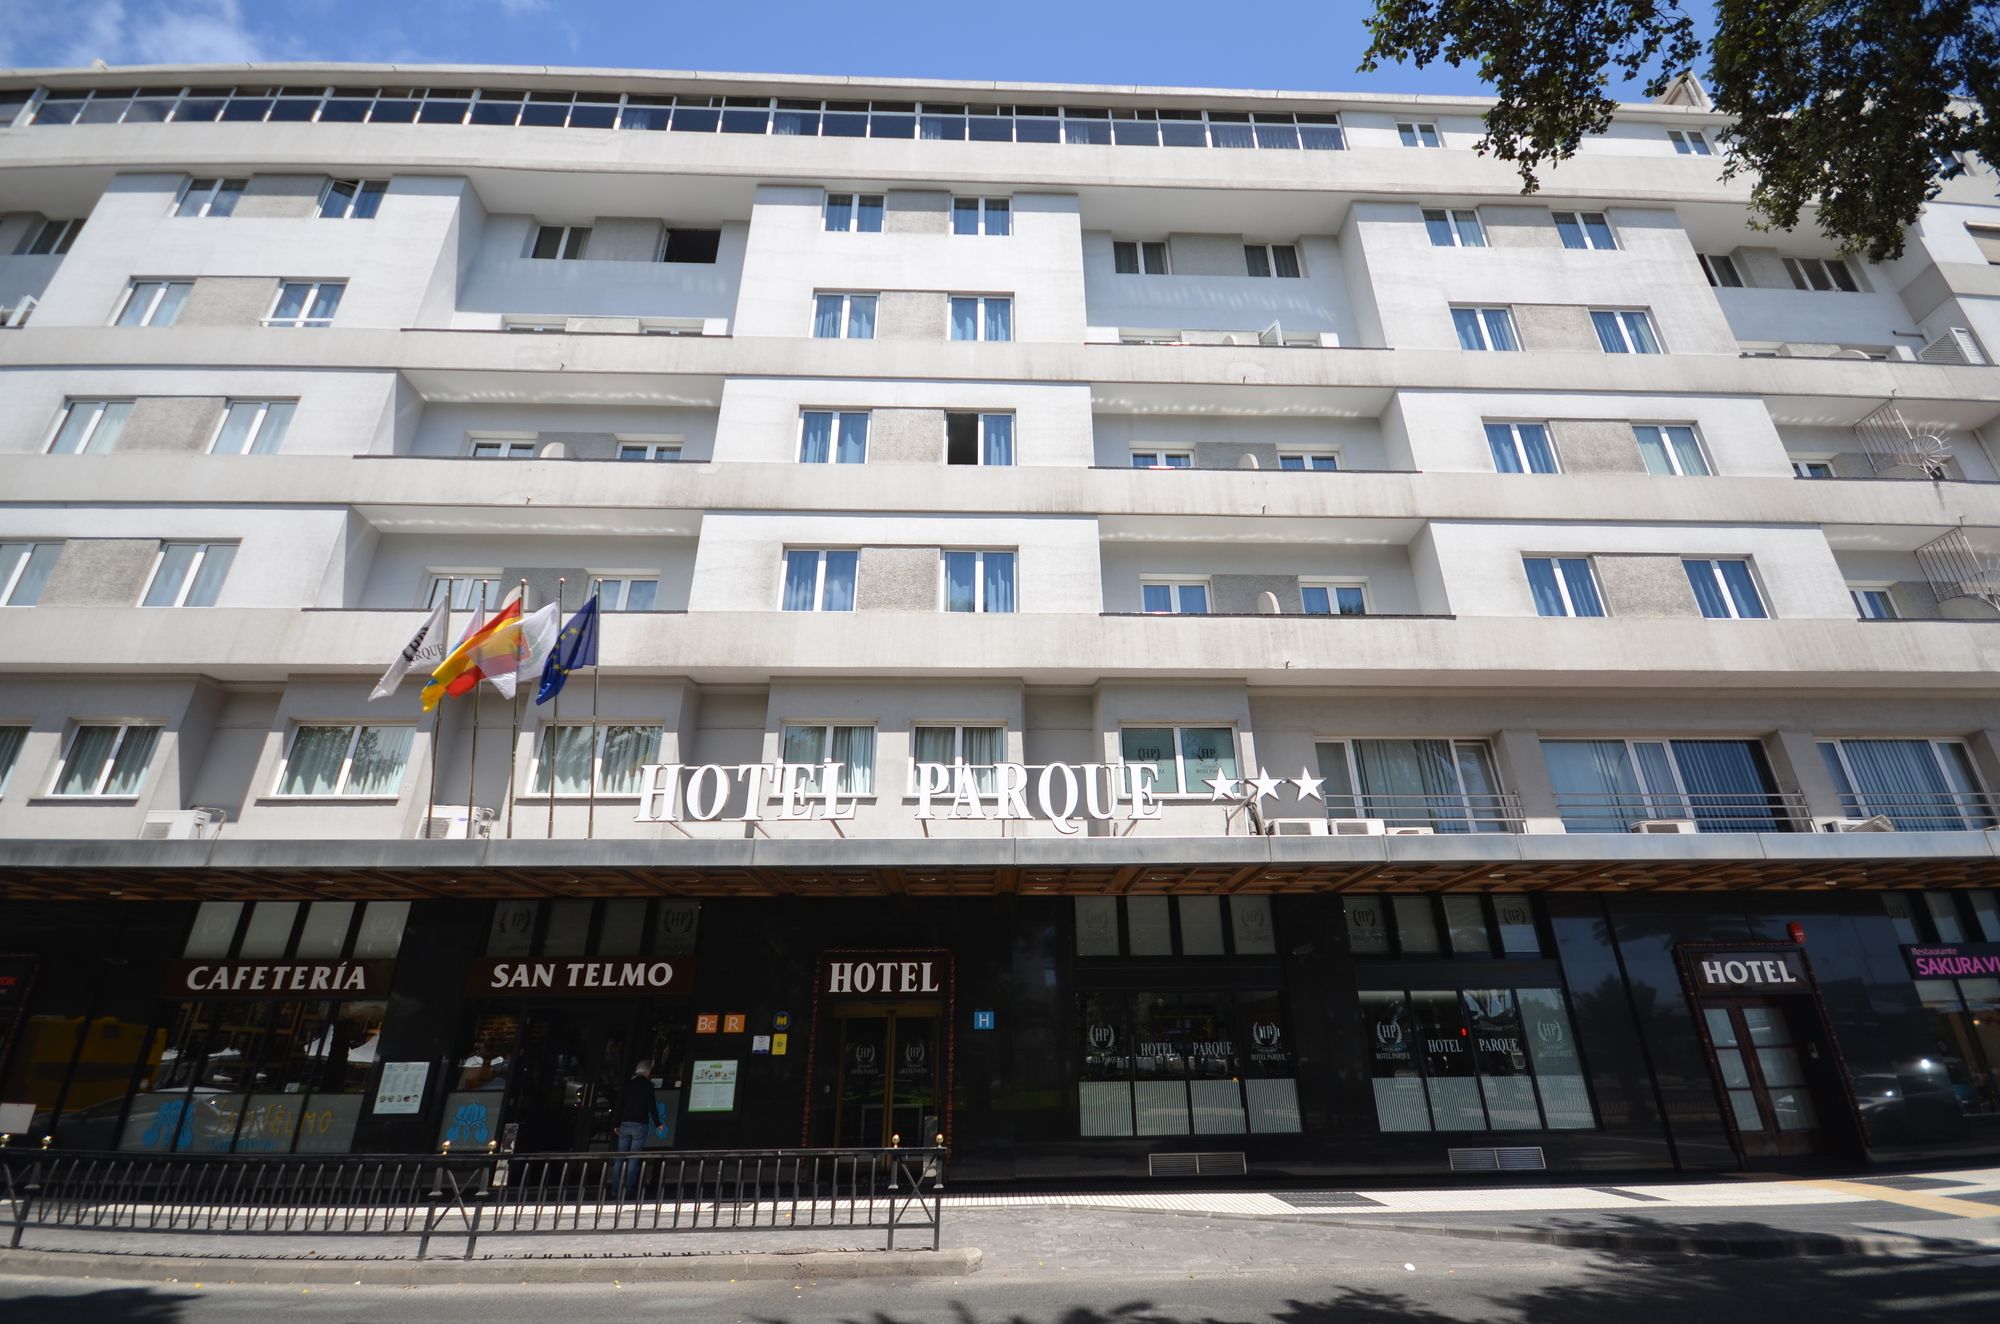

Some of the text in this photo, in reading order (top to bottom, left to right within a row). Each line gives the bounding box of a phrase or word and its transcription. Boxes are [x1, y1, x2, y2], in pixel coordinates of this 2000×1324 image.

[633, 762, 1163, 834] HOTEL PARQUE
[671, 912, 688, 927] HP
[1911, 947, 1958, 956] Restaurante
[1701, 960, 1797, 984] HOTEL
[1916, 956, 1985, 976] SAKURA
[186, 961, 366, 990] CAFETERÍA
[490, 962, 673, 988] SAN TELMO
[828, 962, 939, 993] HOTEL
[698, 1016, 715, 1031] Bc
[728, 1016, 738, 1031] R
[979, 1013, 989, 1027] H
[1095, 1028, 1109, 1041] HP
[1382, 1024, 1396, 1038] HP
[1542, 1023, 1556, 1037] HP
[1140, 1041, 1233, 1057] HOTEL PARQUE
[1427, 1038, 1519, 1054] HOTEL PARQUE
